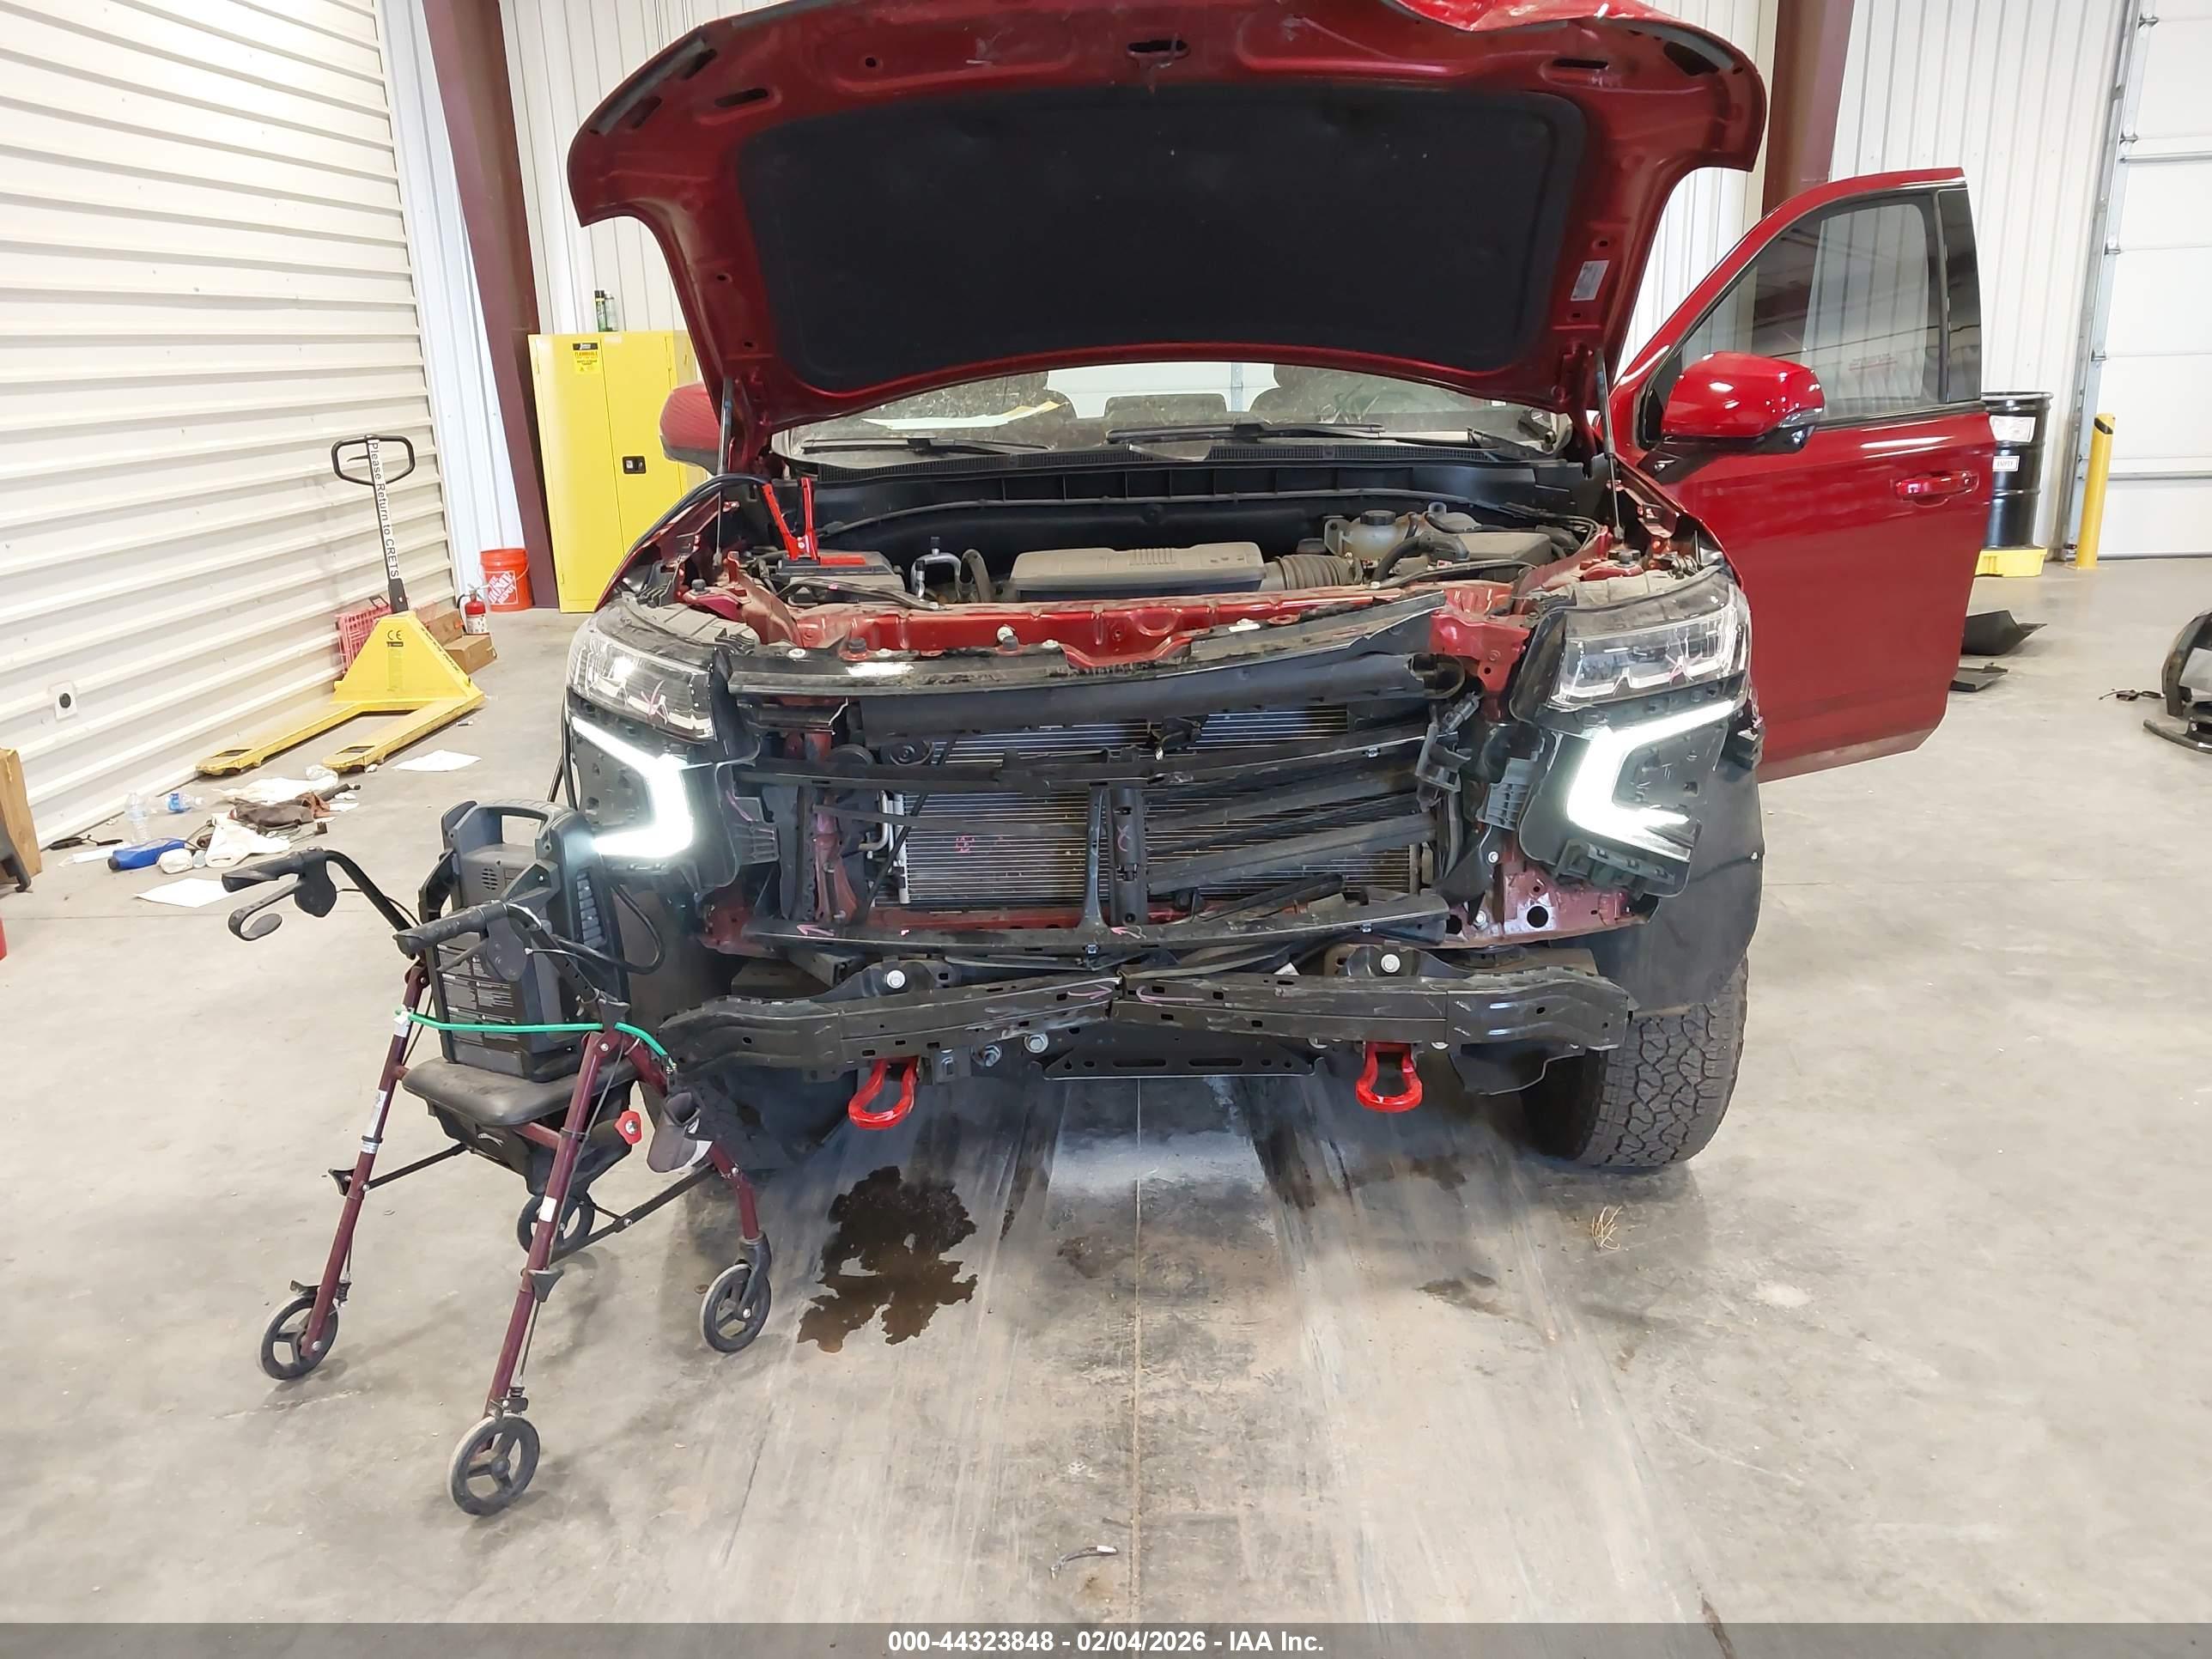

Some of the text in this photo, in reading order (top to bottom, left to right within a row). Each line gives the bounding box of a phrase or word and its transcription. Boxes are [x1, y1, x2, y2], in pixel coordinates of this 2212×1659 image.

[370, 442, 399, 577] Please Return to CRETS
